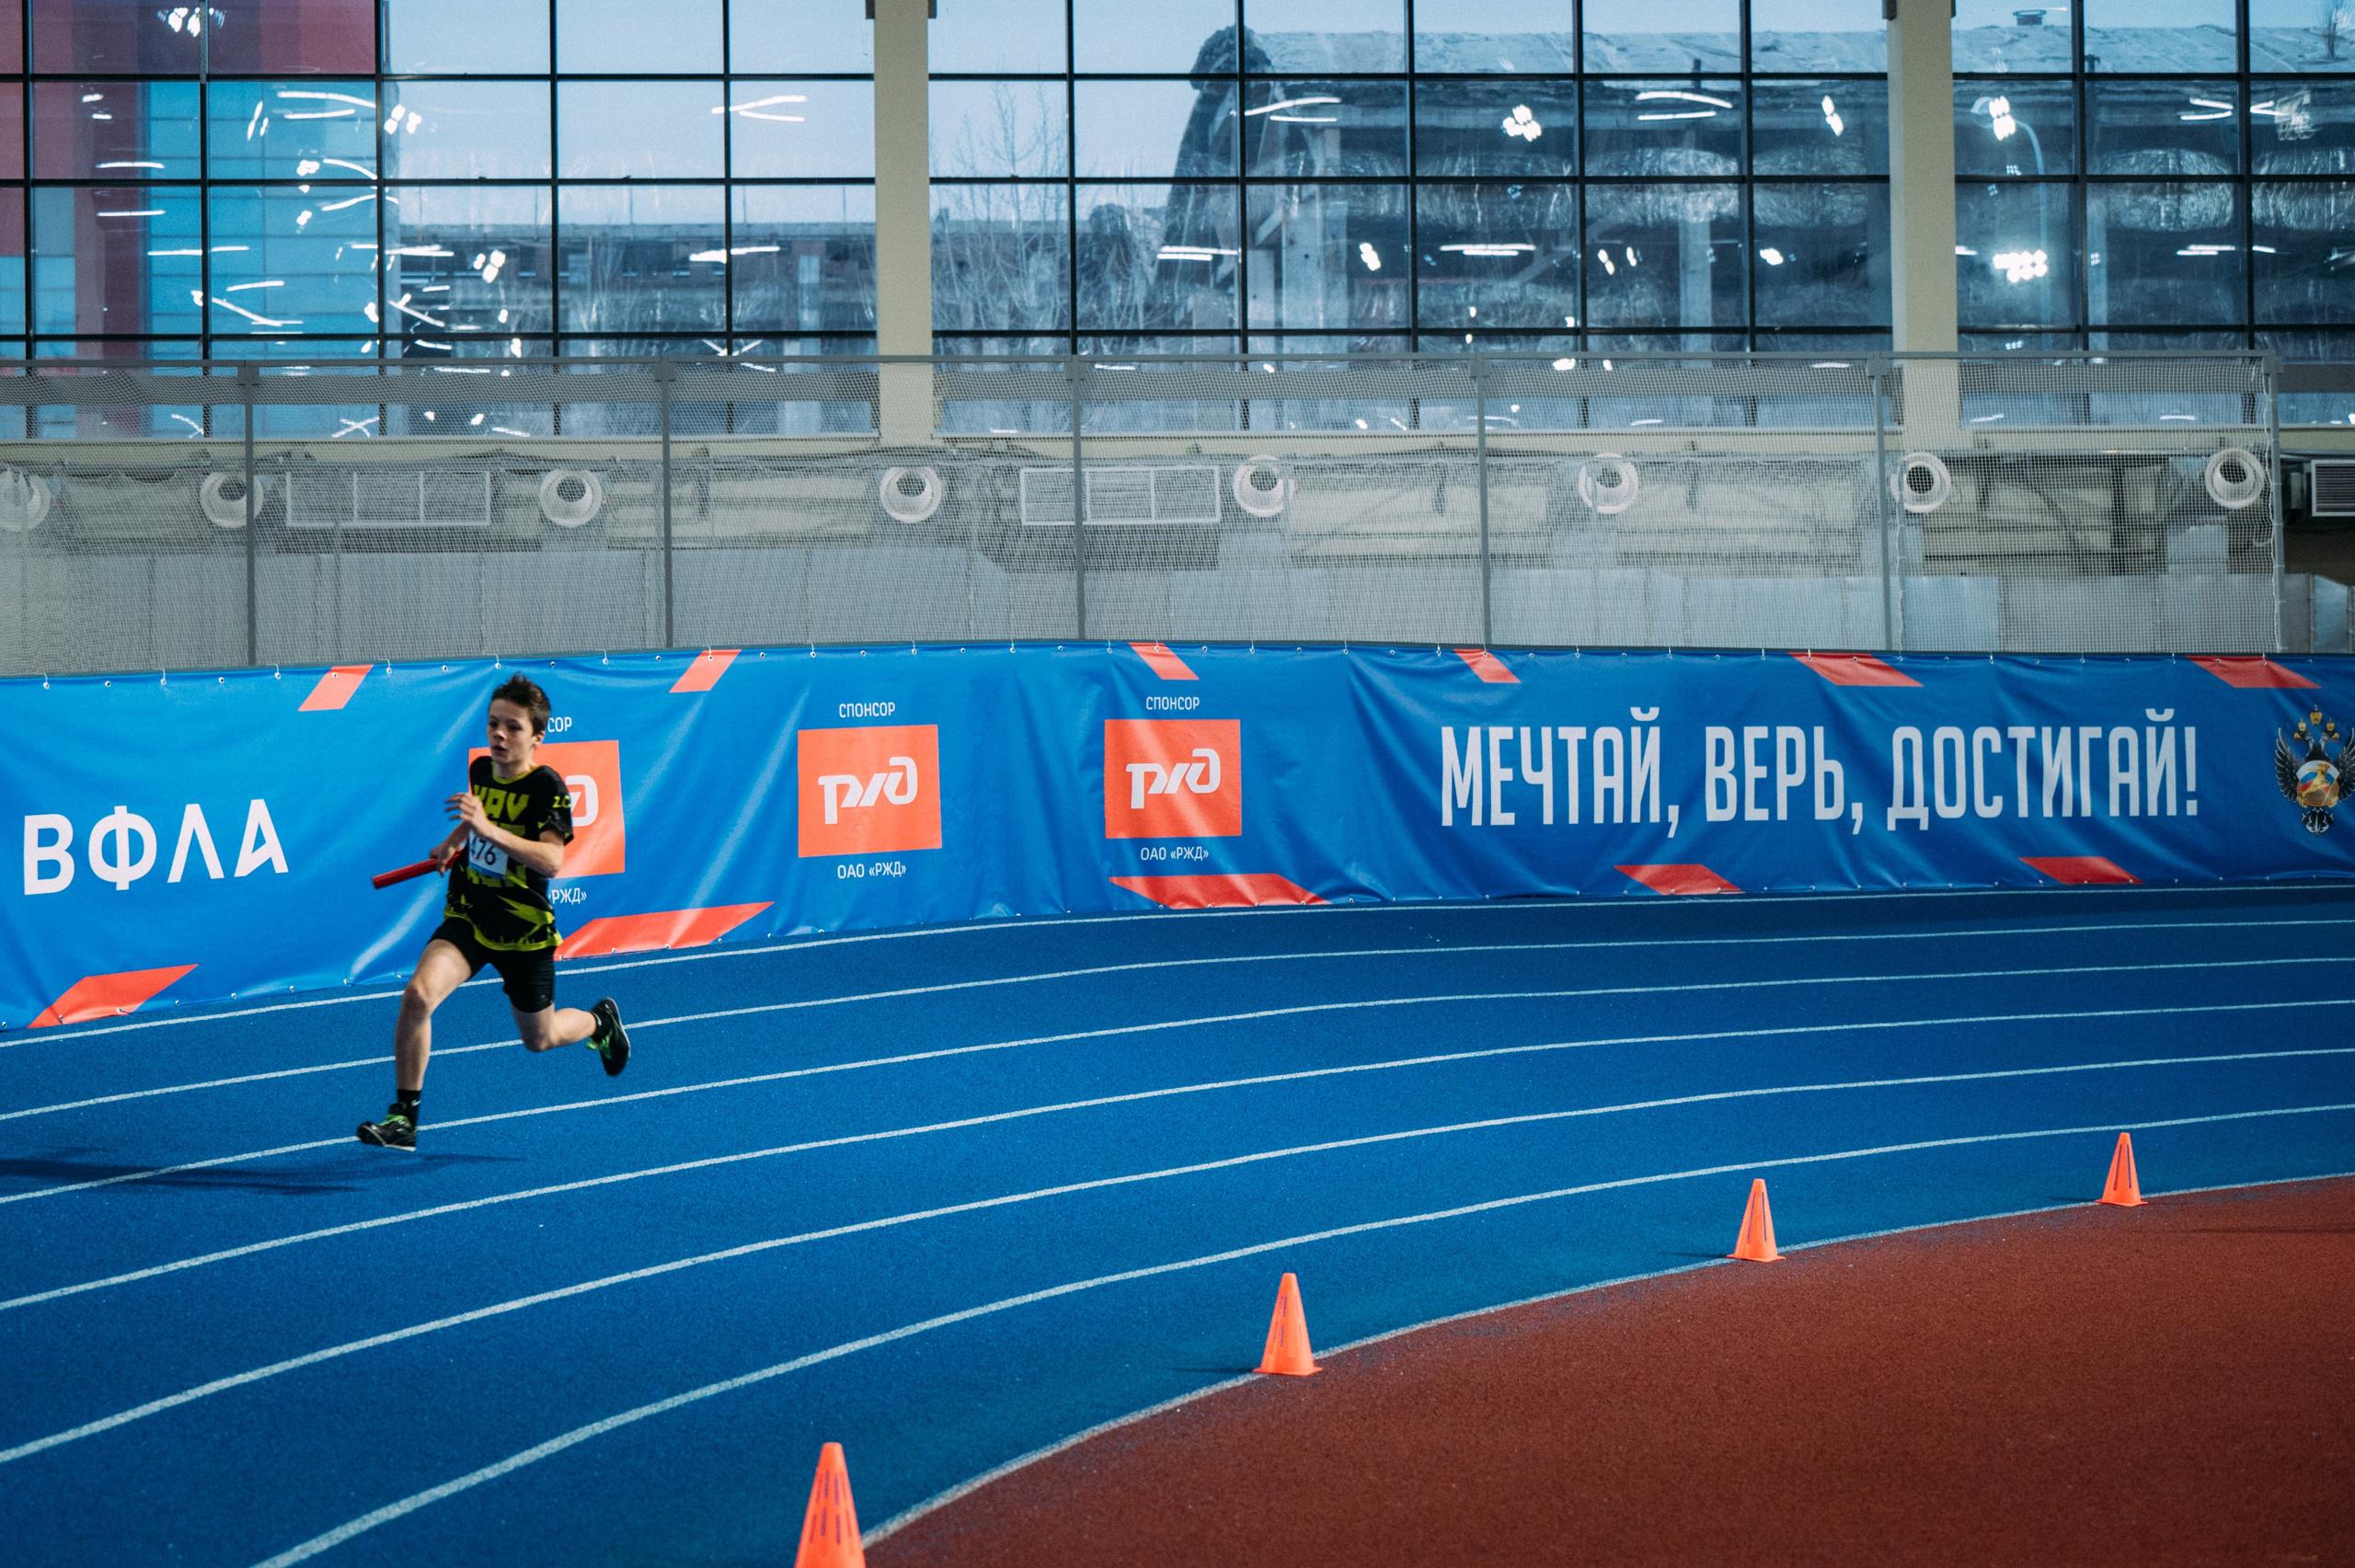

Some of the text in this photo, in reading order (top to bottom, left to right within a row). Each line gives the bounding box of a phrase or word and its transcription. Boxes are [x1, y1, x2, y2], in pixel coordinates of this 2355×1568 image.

[838, 701, 896, 718] СПОНСОР
[1145, 696, 1200, 712] СПОНСОР
[547, 716, 572, 733] СОР
[1441, 706, 2198, 839] МЕЧТАЙ, ВЕРЬ, ДОСТИГАЙ!
[23, 798, 289, 896] ВФЛА
[1140, 846, 1210, 862] ОАО «РЖД»
[836, 861, 907, 880] ОАО «РЖД»
